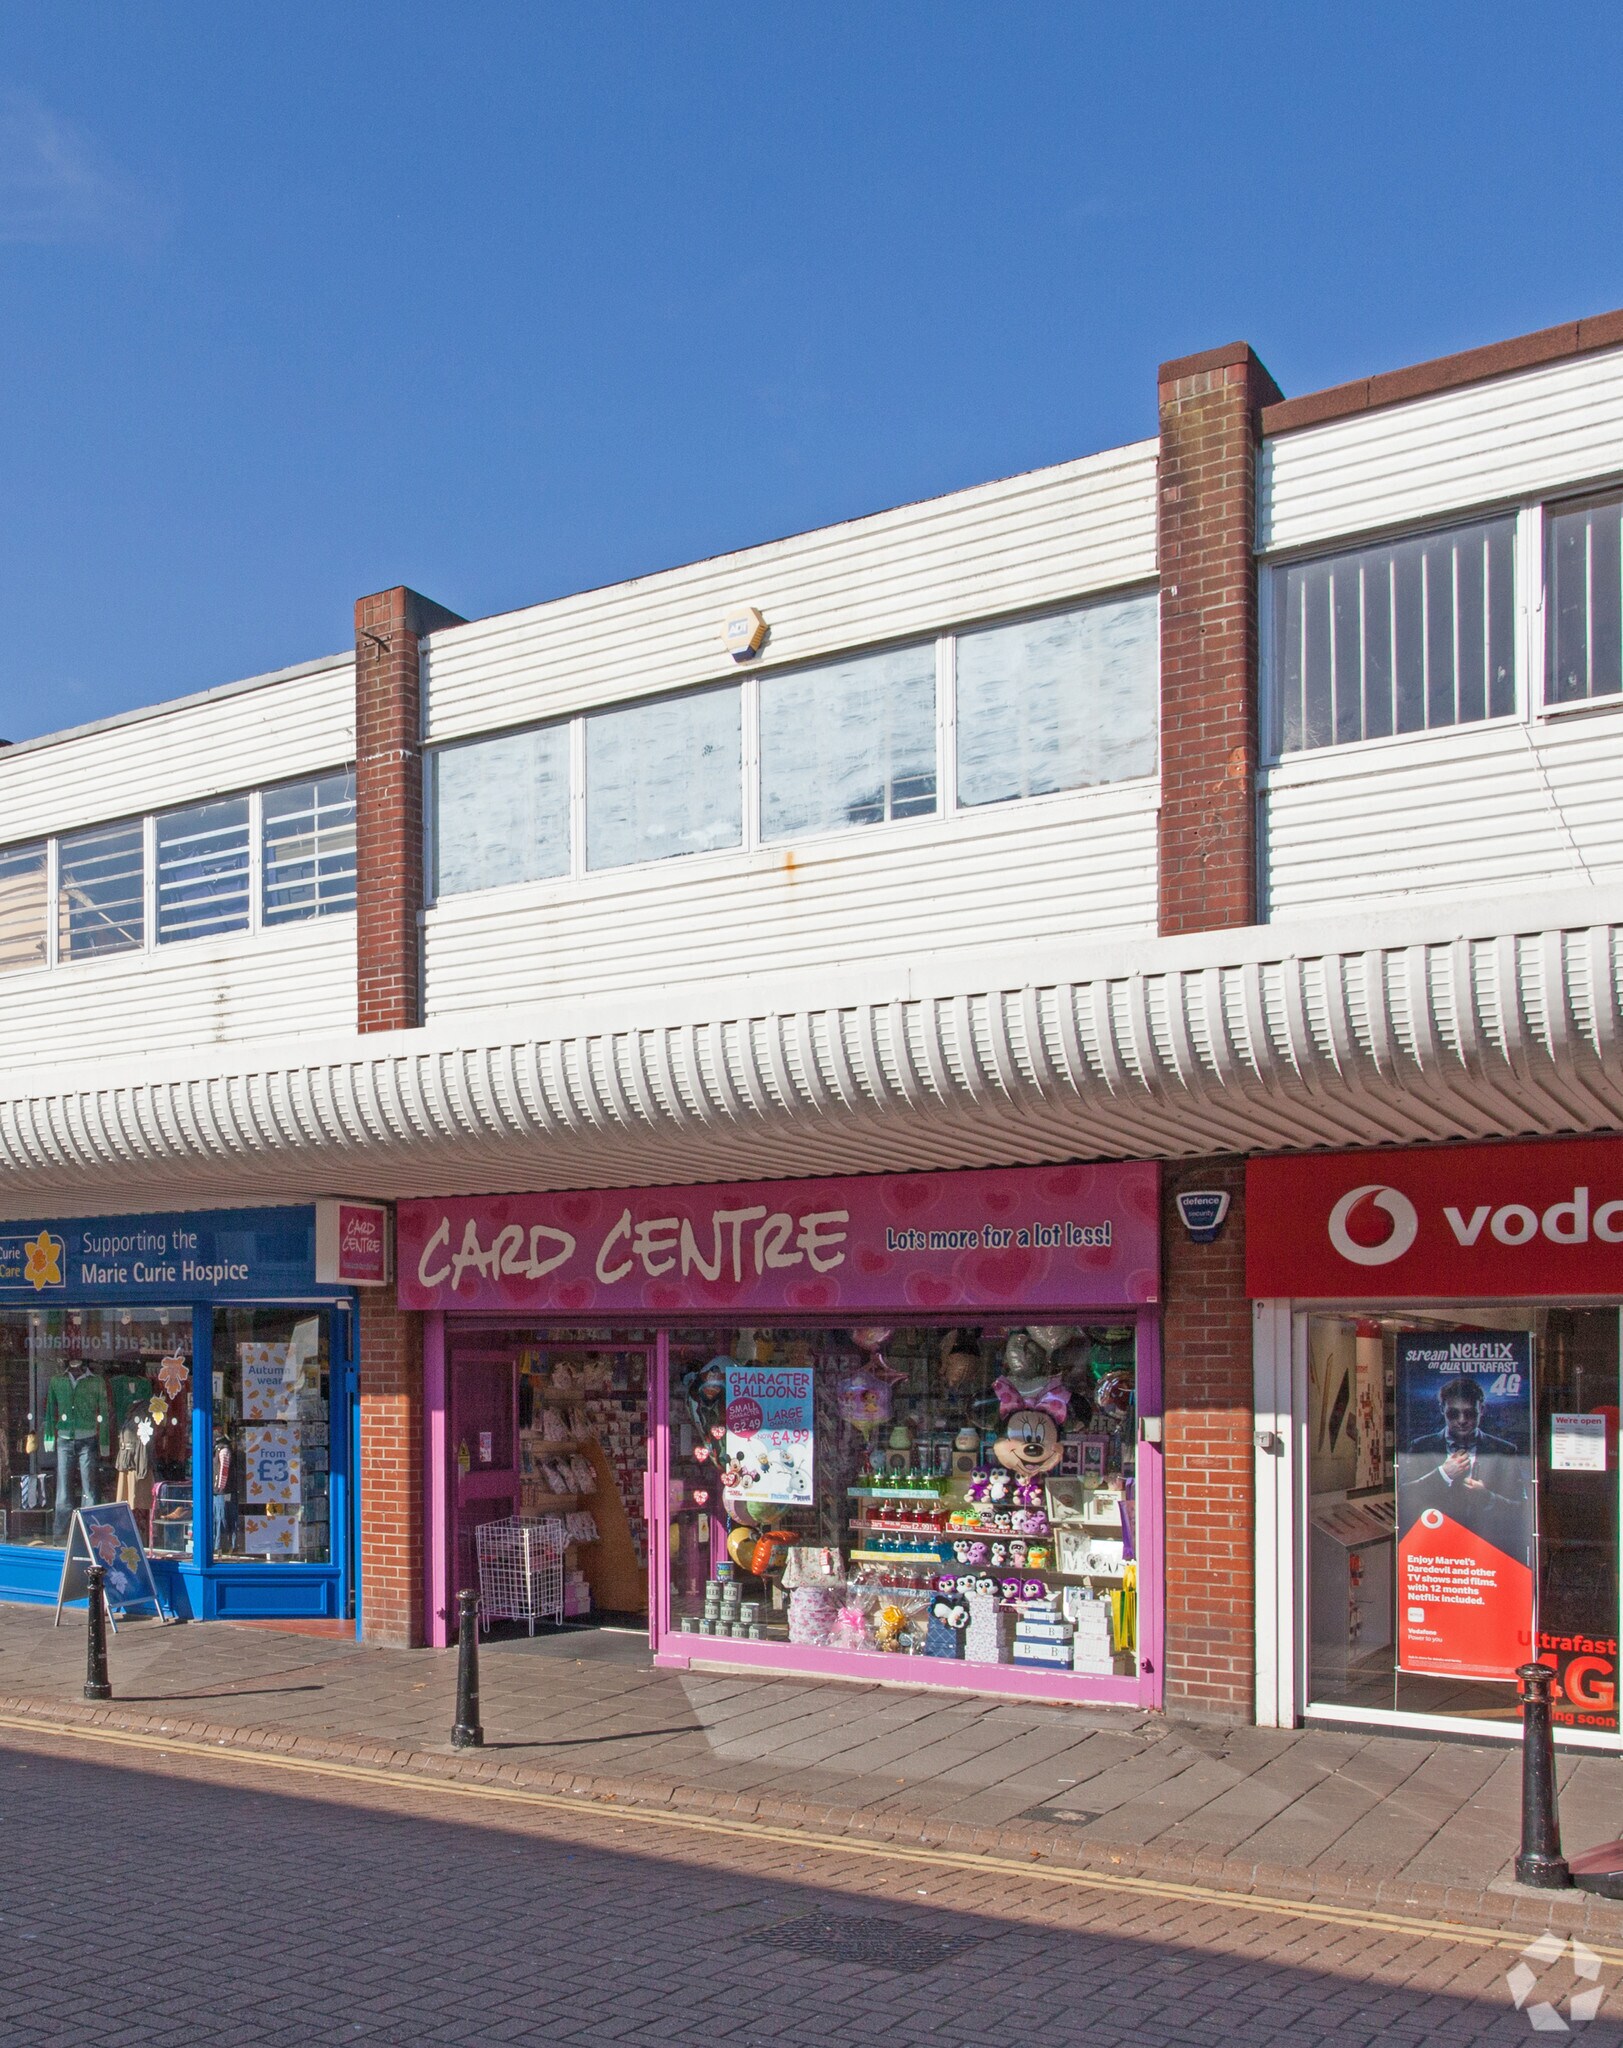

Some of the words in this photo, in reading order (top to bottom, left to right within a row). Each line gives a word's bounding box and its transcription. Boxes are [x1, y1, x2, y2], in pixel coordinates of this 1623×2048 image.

[1183, 1197, 1220, 1205] defence
[347, 1218, 376, 1235] CARD
[83, 1231, 166, 1256] Supporting
[172, 1228, 198, 1249] the
[886, 1227, 926, 1250] Lots
[929, 1231, 978, 1249] more
[983, 1224, 1013, 1248] for
[1016, 1229, 1031, 1247] a
[1033, 1222, 1061, 1247] lot
[1065, 1221, 1111, 1247] less!
[342, 1236, 380, 1253] CENTRE
[418, 1216, 577, 1290] CARD
[595, 1205, 849, 1284] CENTRE
[0, 1264, 21, 1278] Care
[82, 1263, 127, 1284] Marie
[133, 1261, 176, 1283] Curie
[182, 1260, 249, 1286] Hospice
[1405, 1350, 1449, 1361] stream
[1461, 1362, 1518, 1373] ULTRAFAST
[257, 1377, 282, 1385] wear
[729, 1372, 810, 1386] CHARACTER
[1489, 1373, 1521, 1395] 4G
[733, 1385, 807, 1399] BALLOONS
[729, 1402, 757, 1414] SMALL
[767, 1406, 803, 1422] LARGE
[733, 1418, 761, 1433] £2.49
[771, 1428, 810, 1446] £4.99
[257, 1459, 289, 1481] £3
[1407, 1555, 1435, 1565] Enjoy
[1435, 1556, 1476, 1566] Marvel's
[1407, 1565, 1451, 1574] Daredevil
[1452, 1568, 1469, 1576] and
[1470, 1568, 1496, 1577] other
[1407, 1574, 1421, 1582] TV
[1421, 1575, 1451, 1584] shows
[1452, 1577, 1469, 1585] and
[1470, 1578, 1497, 1588] films,
[1407, 1584, 1429, 1592] with
[1430, 1584, 1442, 1593] 12
[1442, 1586, 1479, 1595] months
[1407, 1593, 1441, 1602] Netflix
[1441, 1594, 1485, 1605] included.
[1517, 1630, 1617, 1655] Ultrafast
[1578, 1714, 1616, 1727] soon
